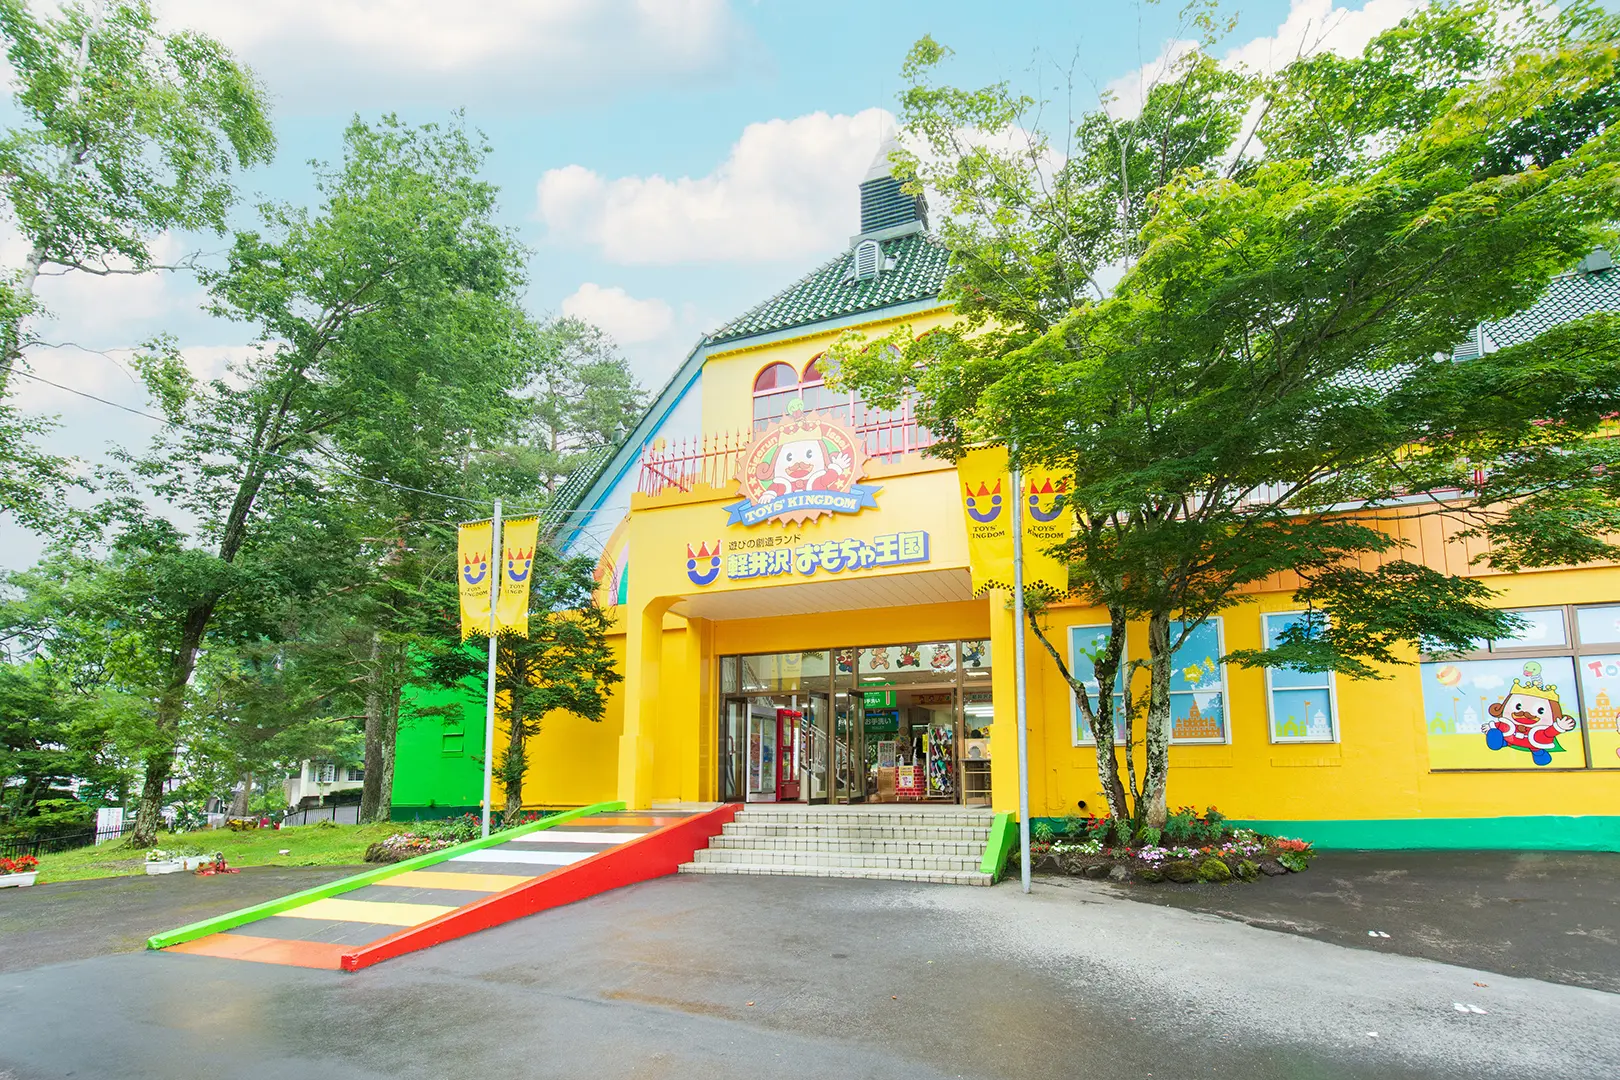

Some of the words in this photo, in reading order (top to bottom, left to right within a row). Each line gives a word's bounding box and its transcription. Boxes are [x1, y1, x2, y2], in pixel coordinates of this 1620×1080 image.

[744, 499, 785, 523] TOYS'
[787, 494, 857, 510] KINGDOM
[728, 534, 802, 551] 遊びの創造ランド
[970, 530, 1005, 539] INGDOM
